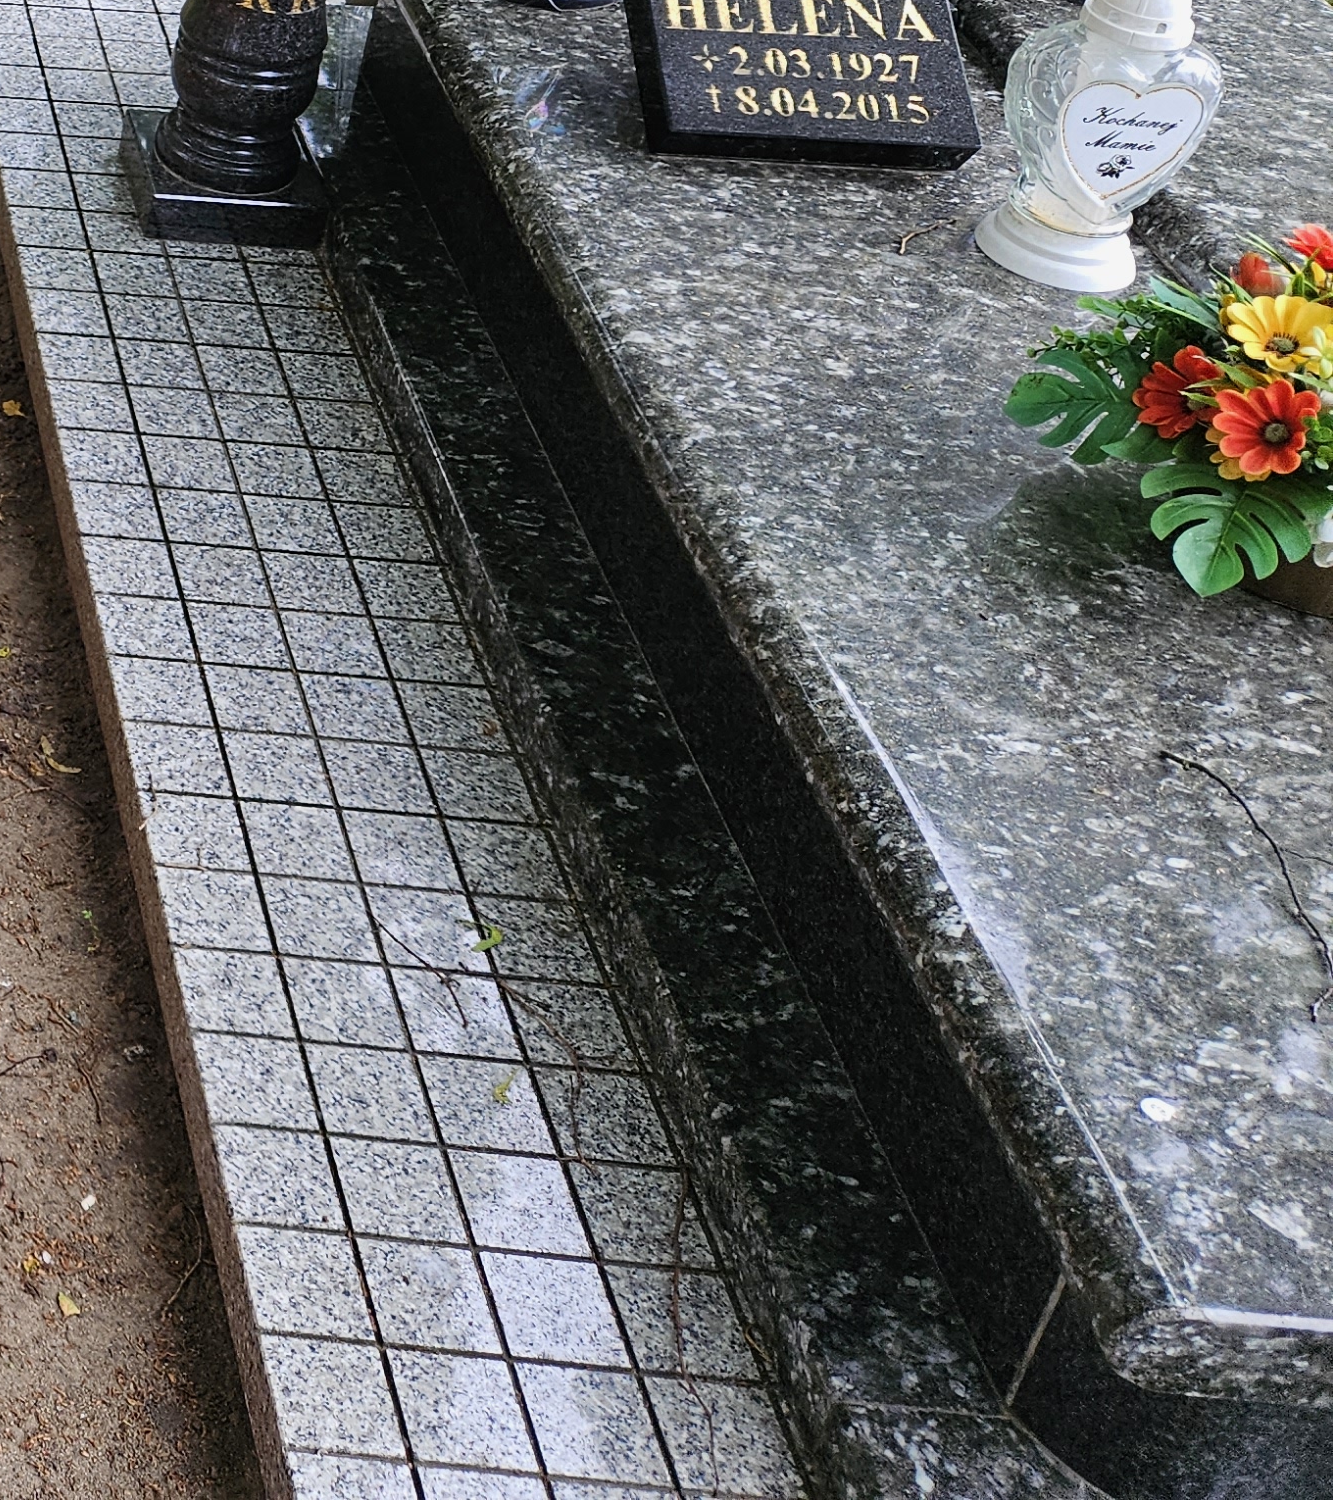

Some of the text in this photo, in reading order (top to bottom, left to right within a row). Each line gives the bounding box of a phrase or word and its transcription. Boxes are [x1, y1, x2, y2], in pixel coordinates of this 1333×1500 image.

[728, 45, 921, 85] 2.03.1927
[734, 84, 932, 126] 8.04.2015
[1083, 105, 1181, 137] Kochanej
[1085, 130, 1158, 153] Mamie
